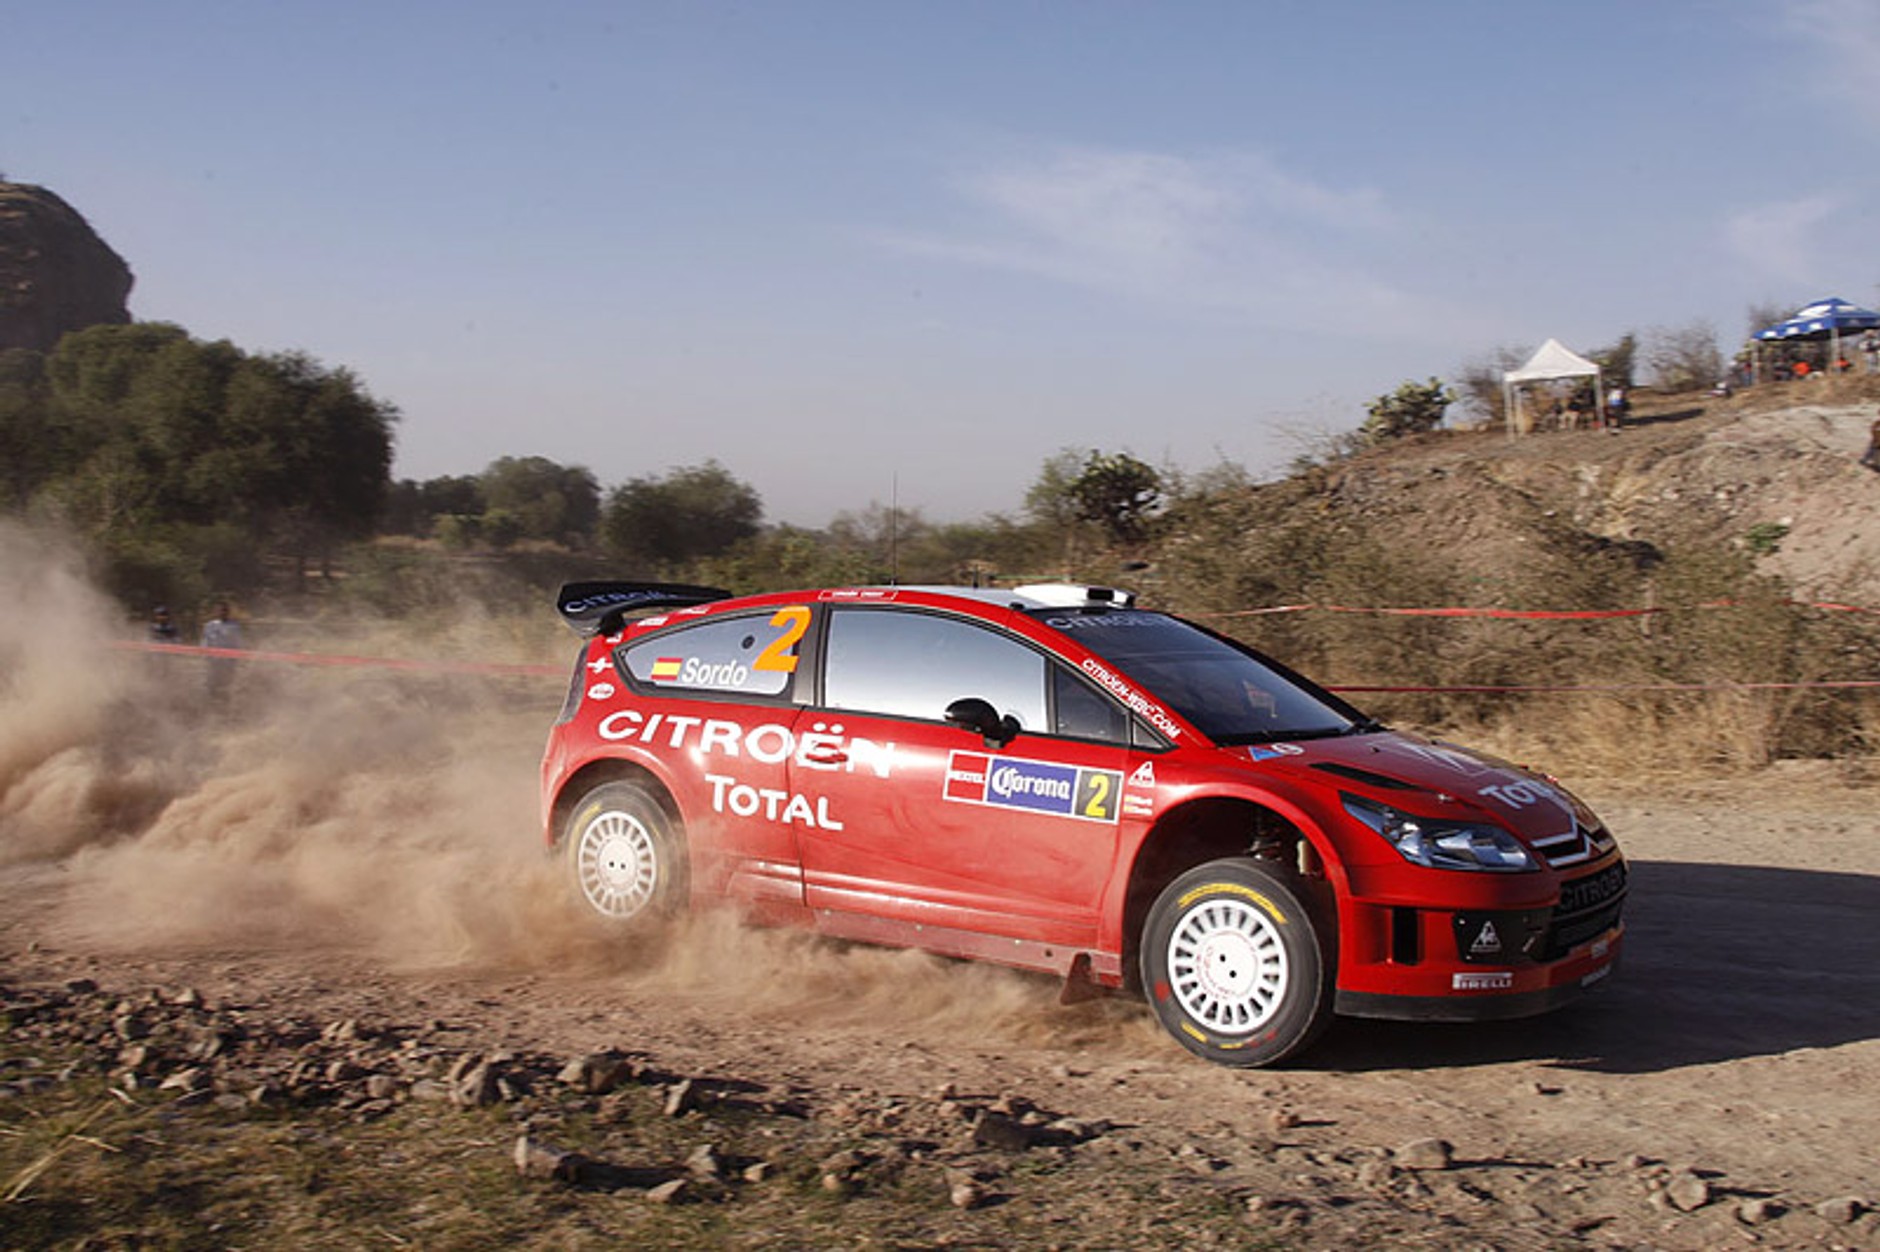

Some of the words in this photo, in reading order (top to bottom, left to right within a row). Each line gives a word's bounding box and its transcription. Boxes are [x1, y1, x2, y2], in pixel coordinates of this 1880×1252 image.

[752, 605, 812, 673] 2
[682, 657, 747, 686] Sordo
[598, 710, 897, 779] CITROËN
[705, 773, 844, 831] TOTAL
[991, 765, 1071, 801] Corona
[1085, 774, 1110, 818] 2
[1452, 972, 1512, 990] PIRELLI
